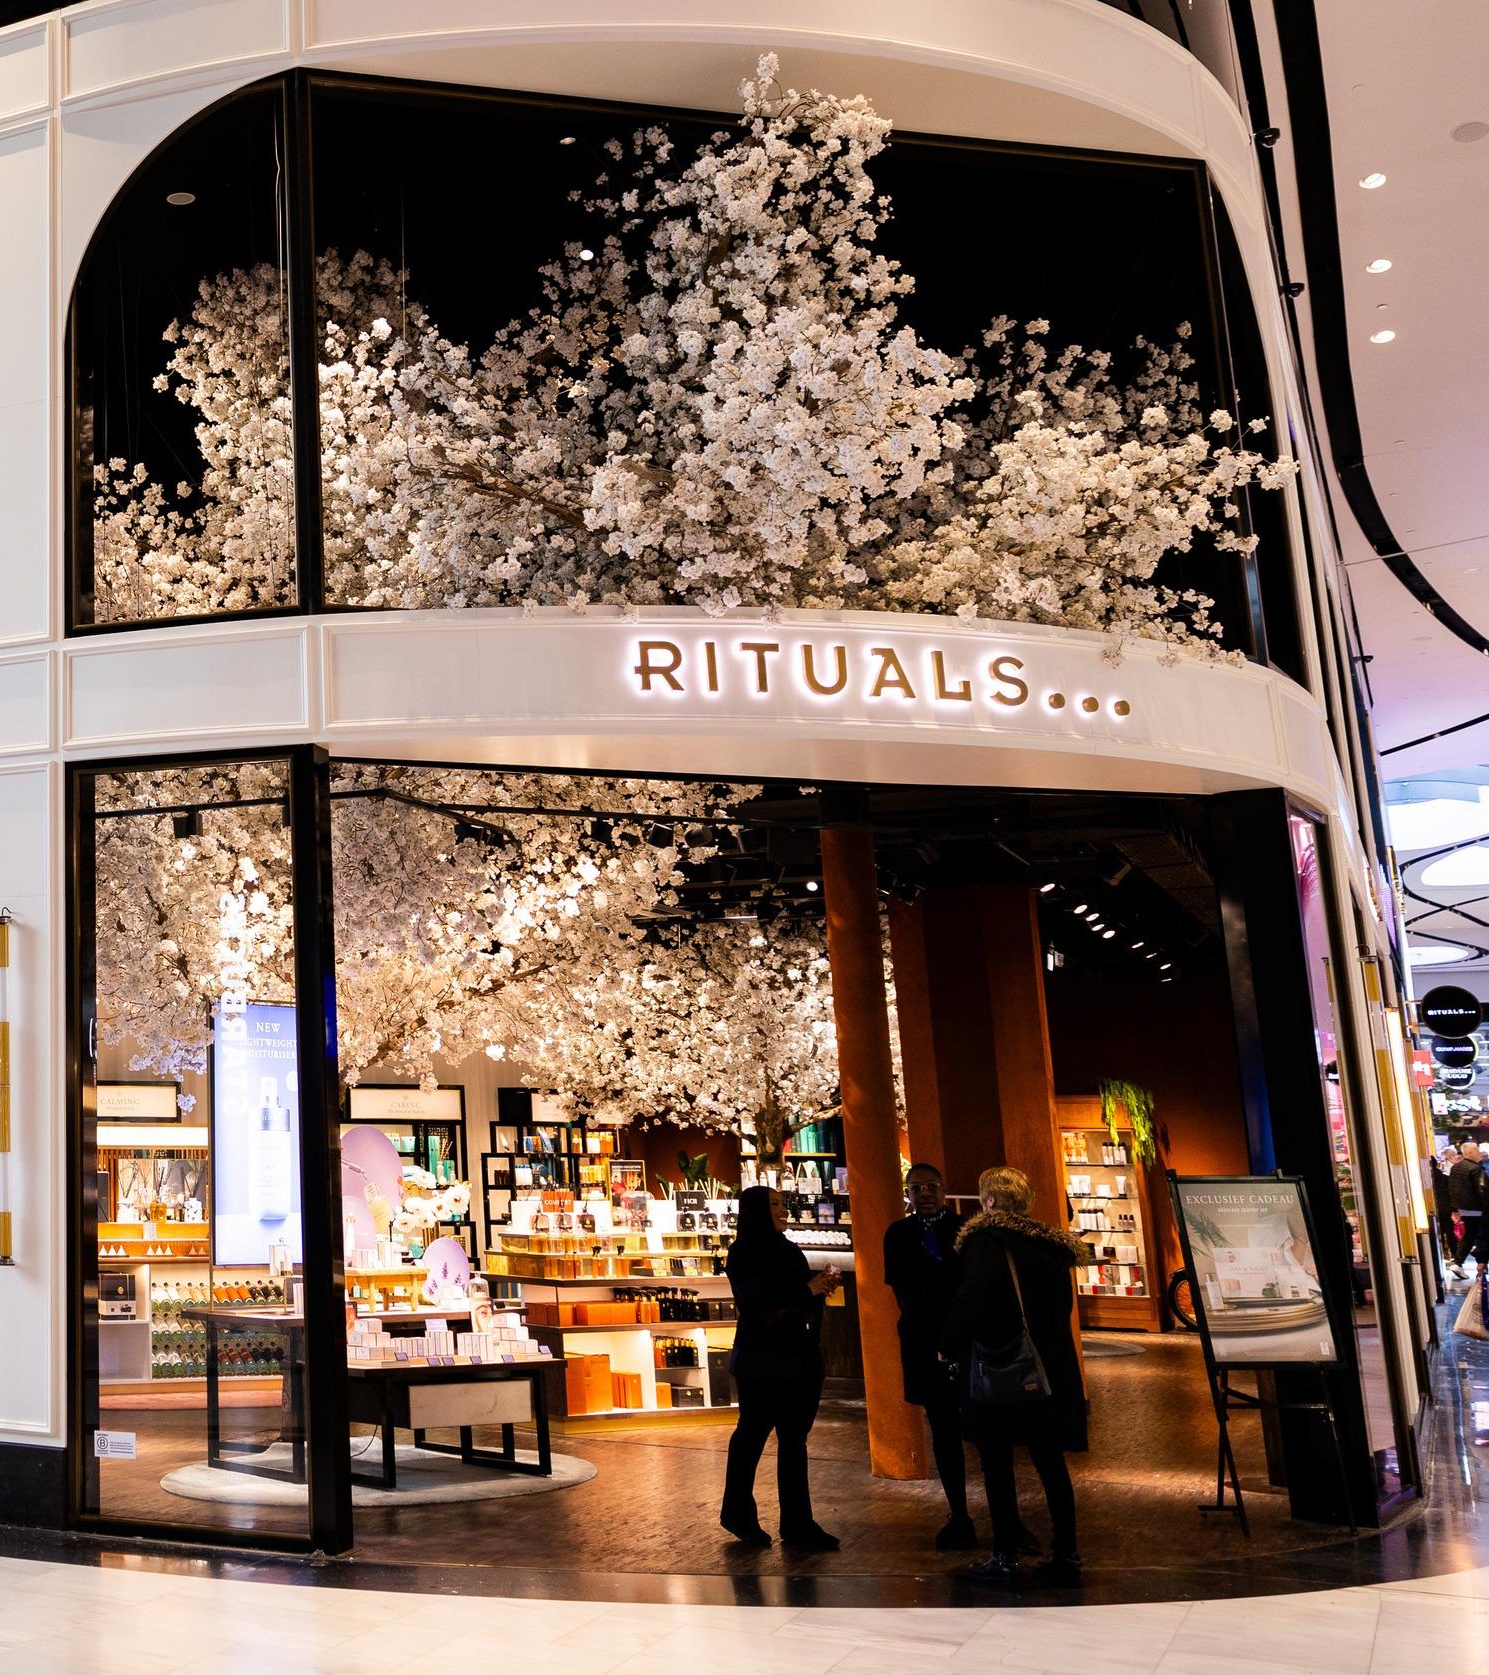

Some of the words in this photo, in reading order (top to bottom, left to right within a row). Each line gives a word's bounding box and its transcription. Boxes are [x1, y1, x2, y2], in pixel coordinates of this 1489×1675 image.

[634, 640, 1131, 716] RITUALS...
[256, 1022, 280, 1033] NEW
[390, 1101, 421, 1109] CARING
[1186, 1194, 1246, 1204] EXCLUSIEF
[1248, 1194, 1294, 1204] CADEAU
